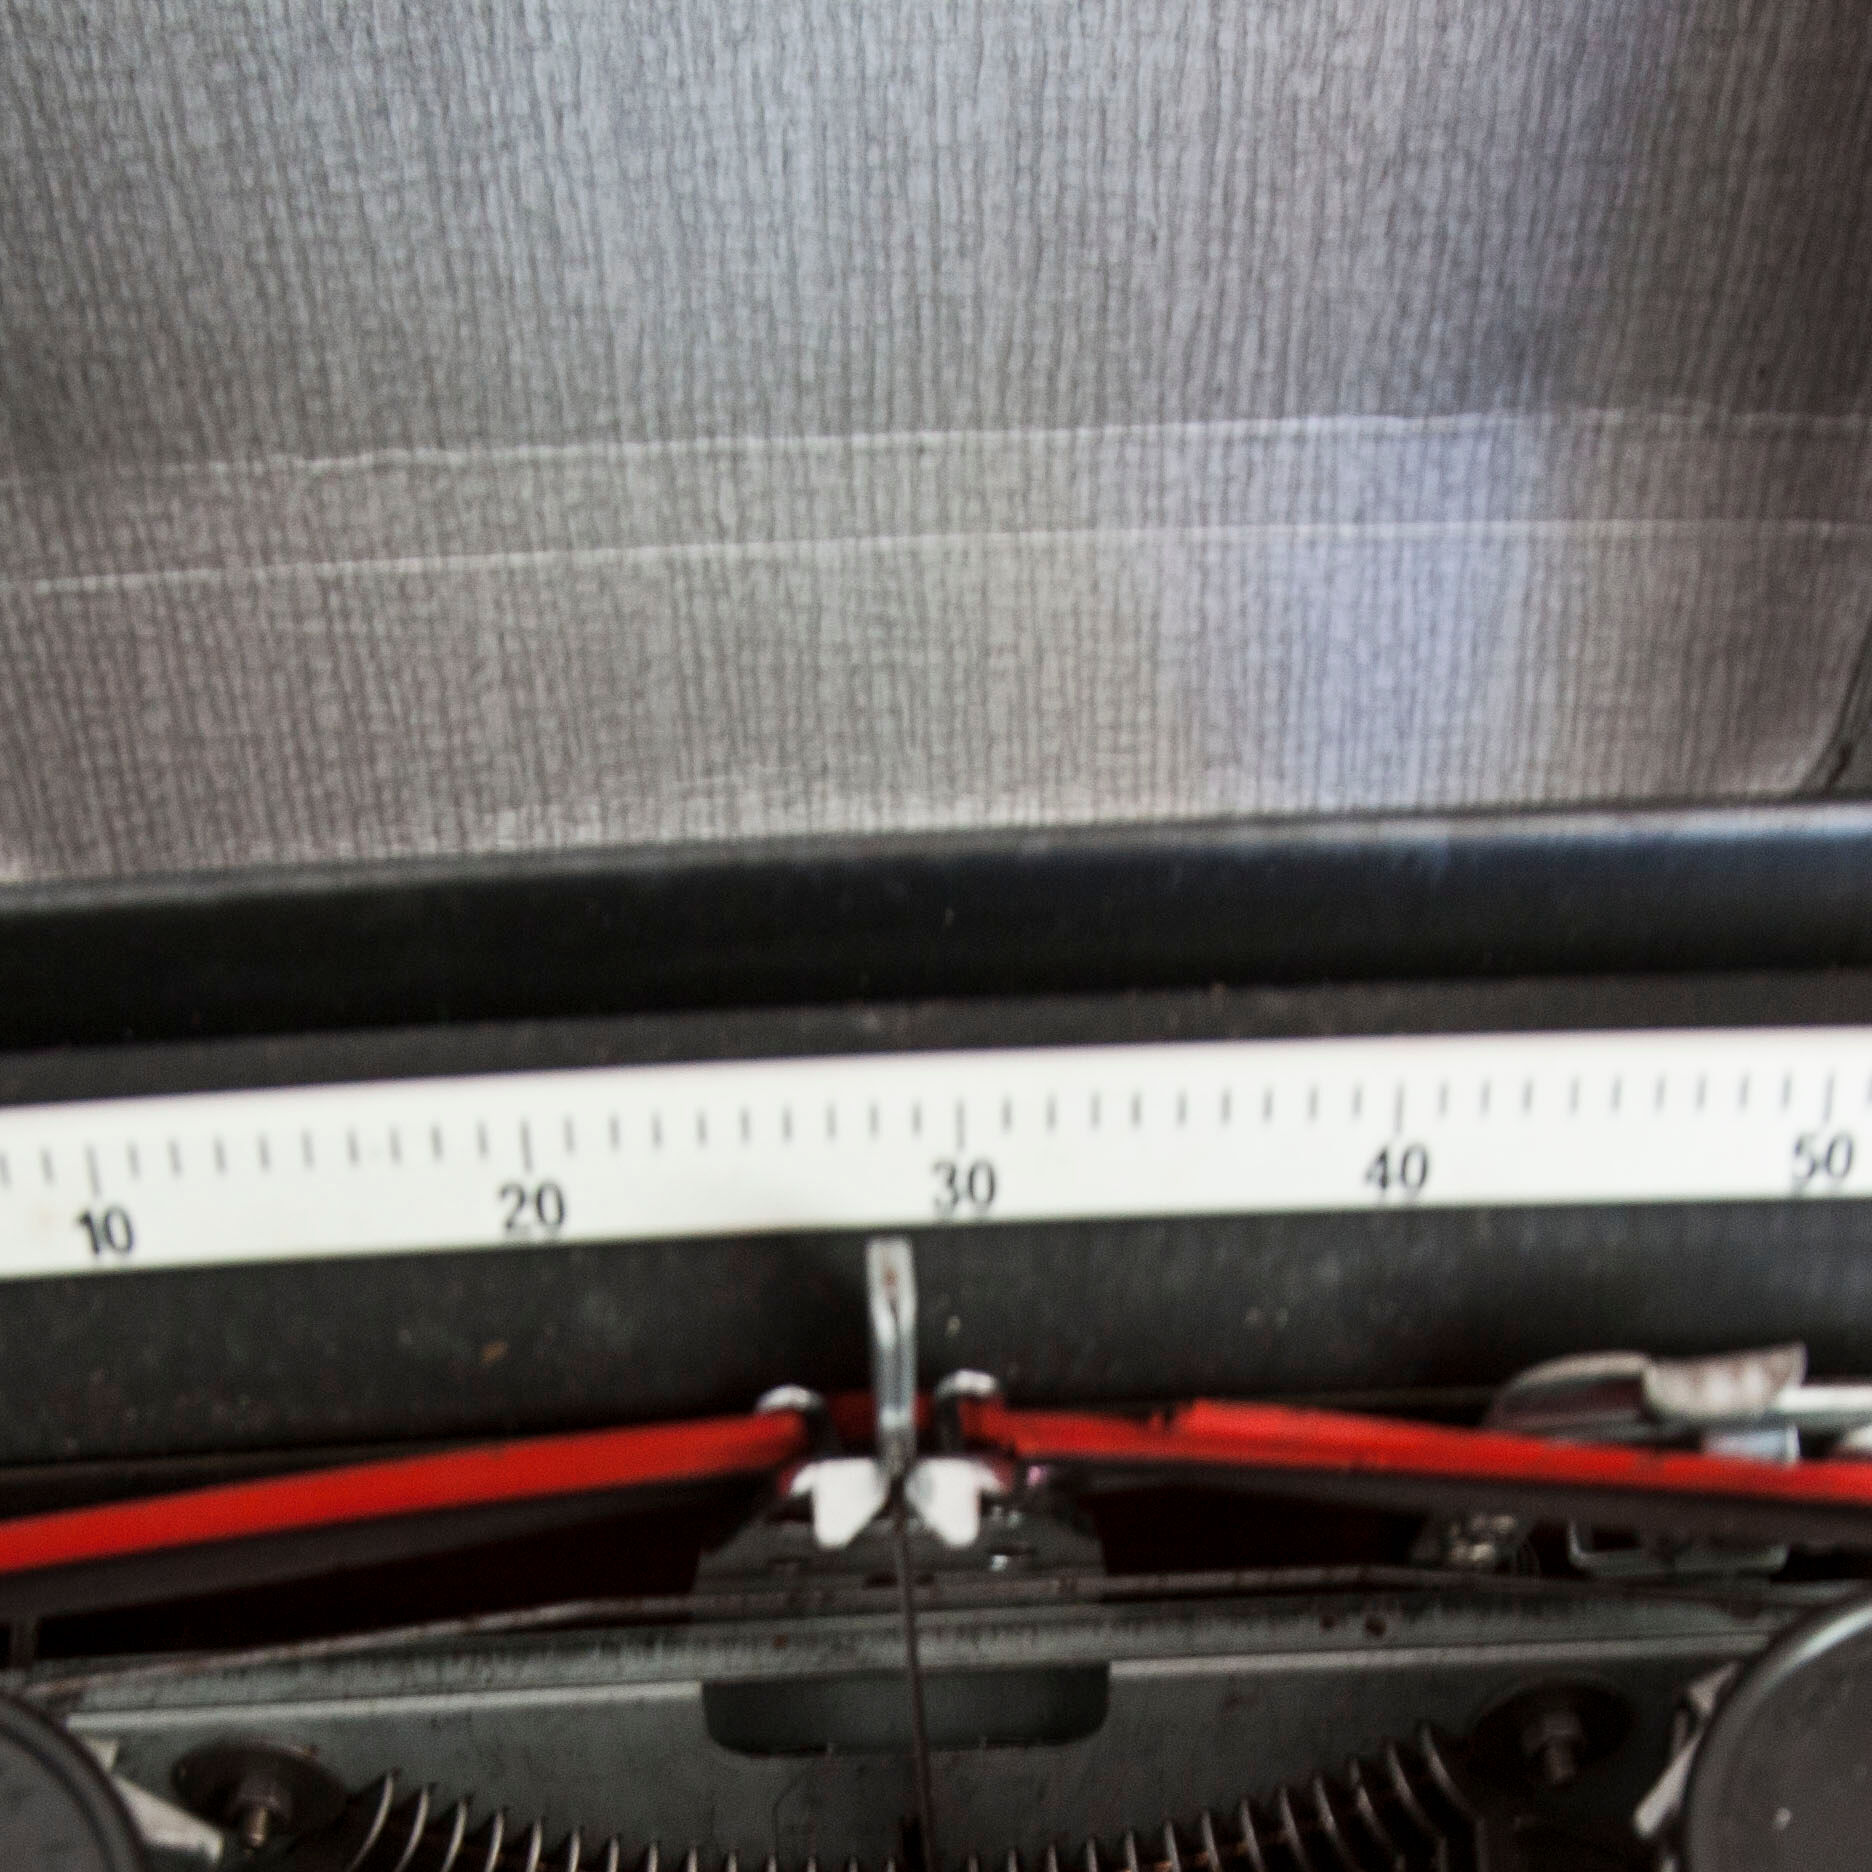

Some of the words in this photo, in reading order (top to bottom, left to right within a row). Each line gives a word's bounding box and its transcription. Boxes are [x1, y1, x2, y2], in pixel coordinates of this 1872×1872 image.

[76, 1206, 135, 1260] 10
[497, 1180, 569, 1238] 20
[931, 1158, 999, 1220] 30
[1362, 1142, 1431, 1200] 40
[1789, 1131, 1856, 1184] 50
